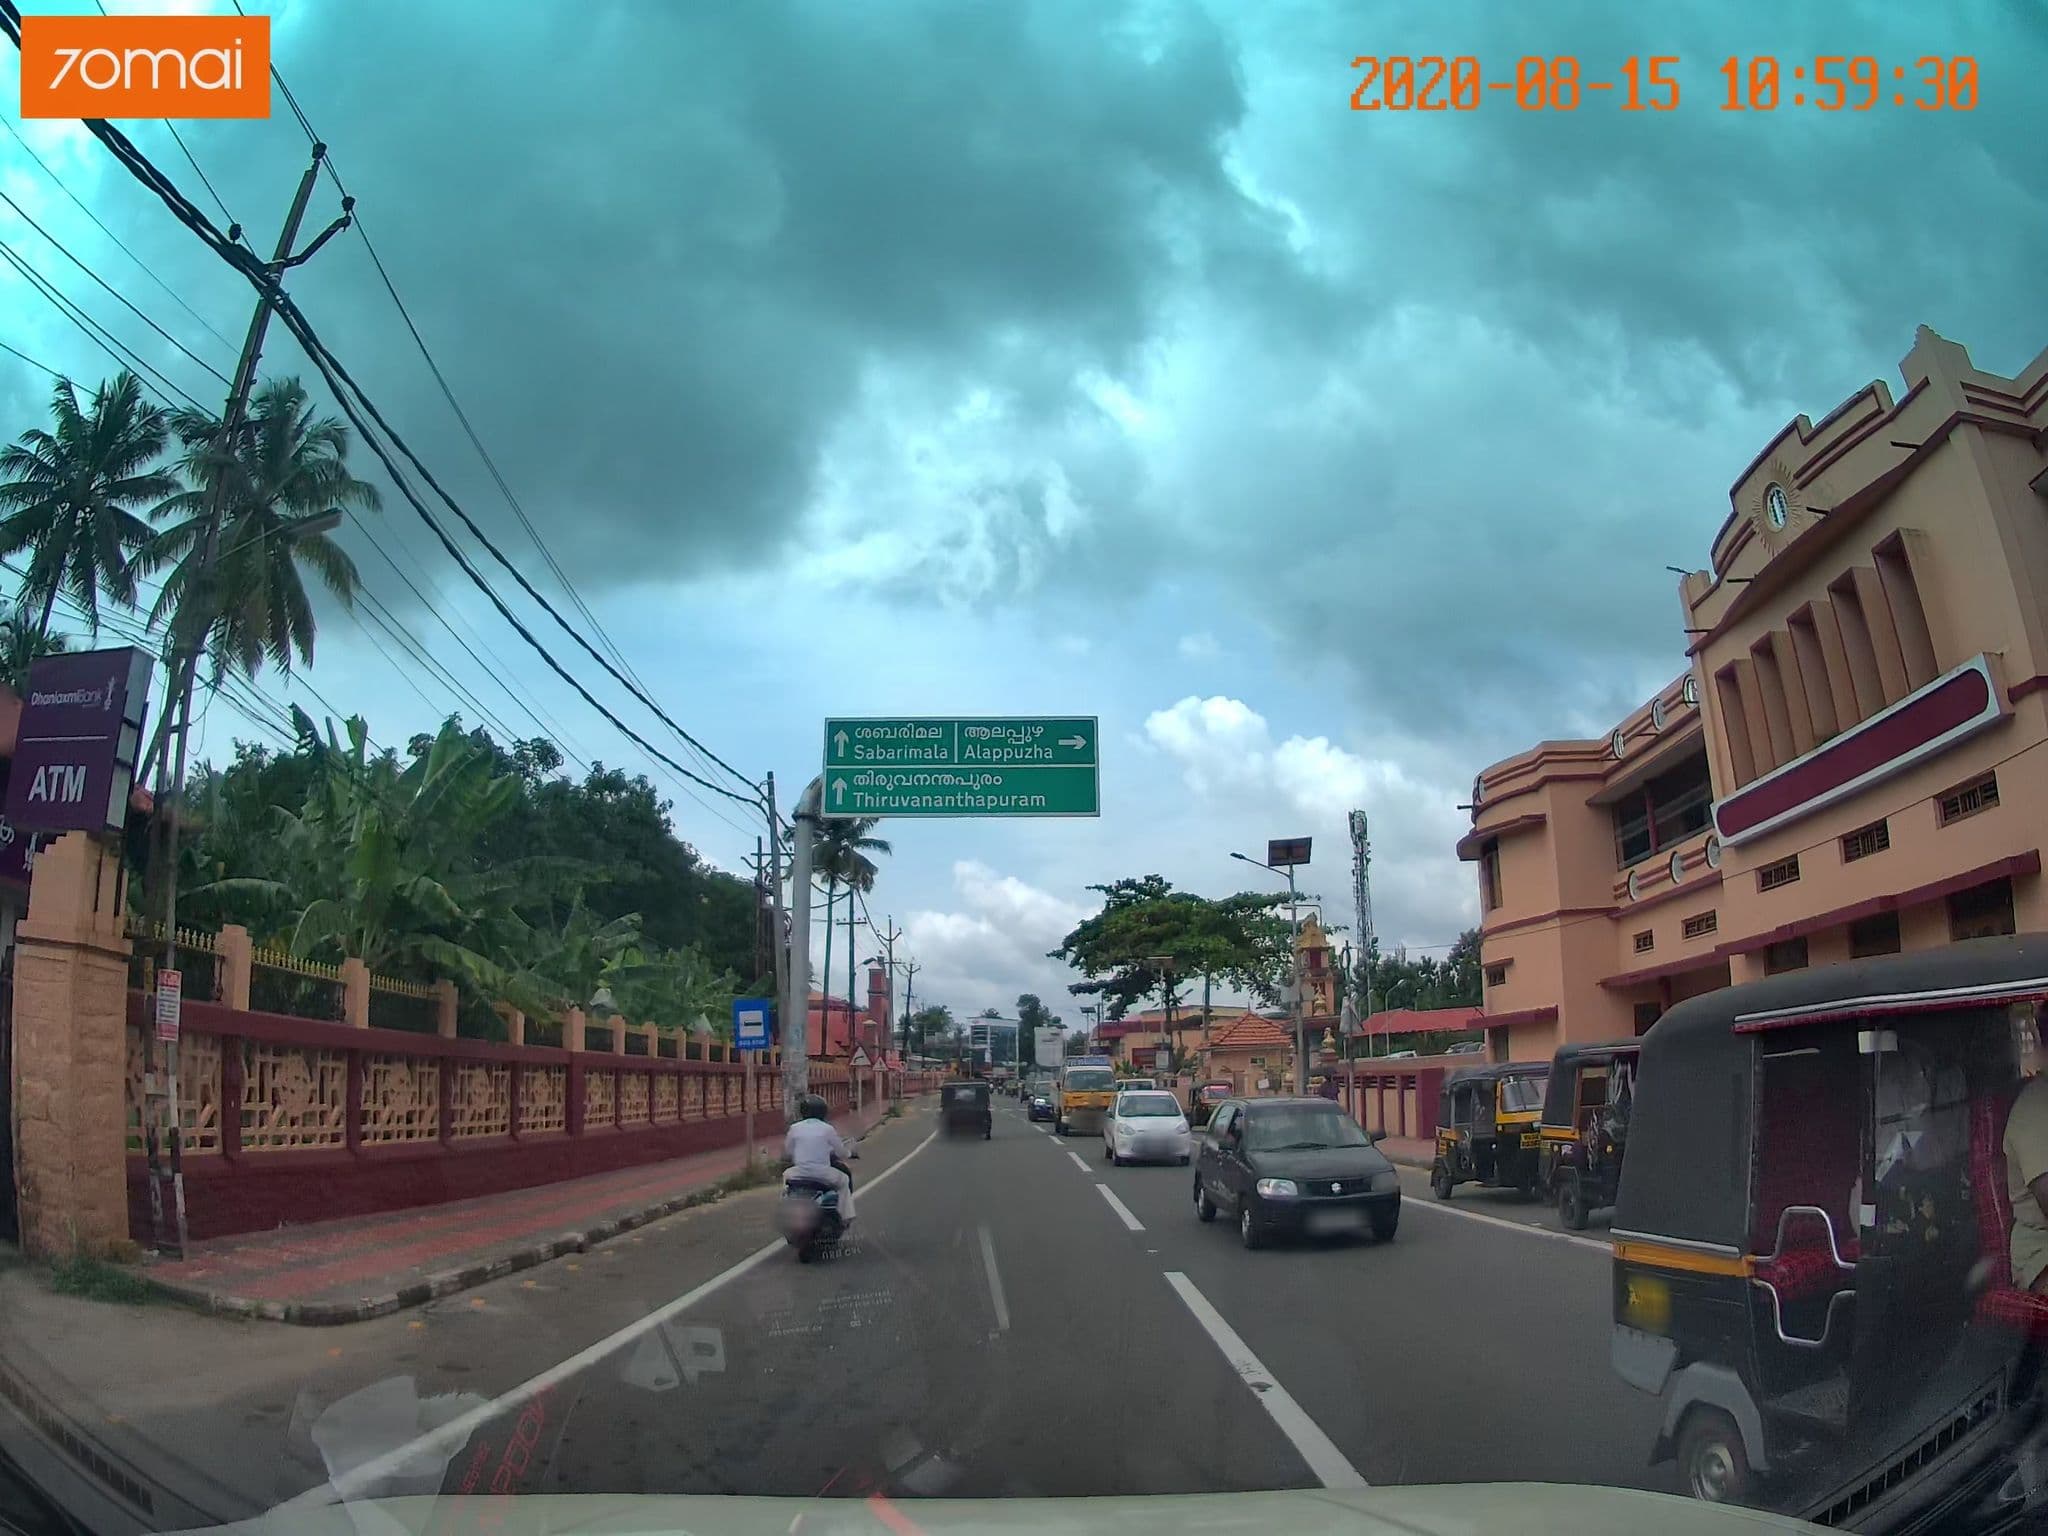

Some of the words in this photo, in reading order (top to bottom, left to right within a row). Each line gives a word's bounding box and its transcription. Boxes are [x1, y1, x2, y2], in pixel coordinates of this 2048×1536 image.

[855, 723, 942, 739] ശബരിമല
[964, 726, 1044, 745] ആലപ്പുഴ
[854, 744, 948, 760] Sabarimala
[964, 743, 1053, 762] Alappuzha
[28, 765, 87, 802] ATM
[853, 770, 1003, 791] തിരുവനന്തപുരം
[853, 791, 1046, 809] Thiruvananthapuram
